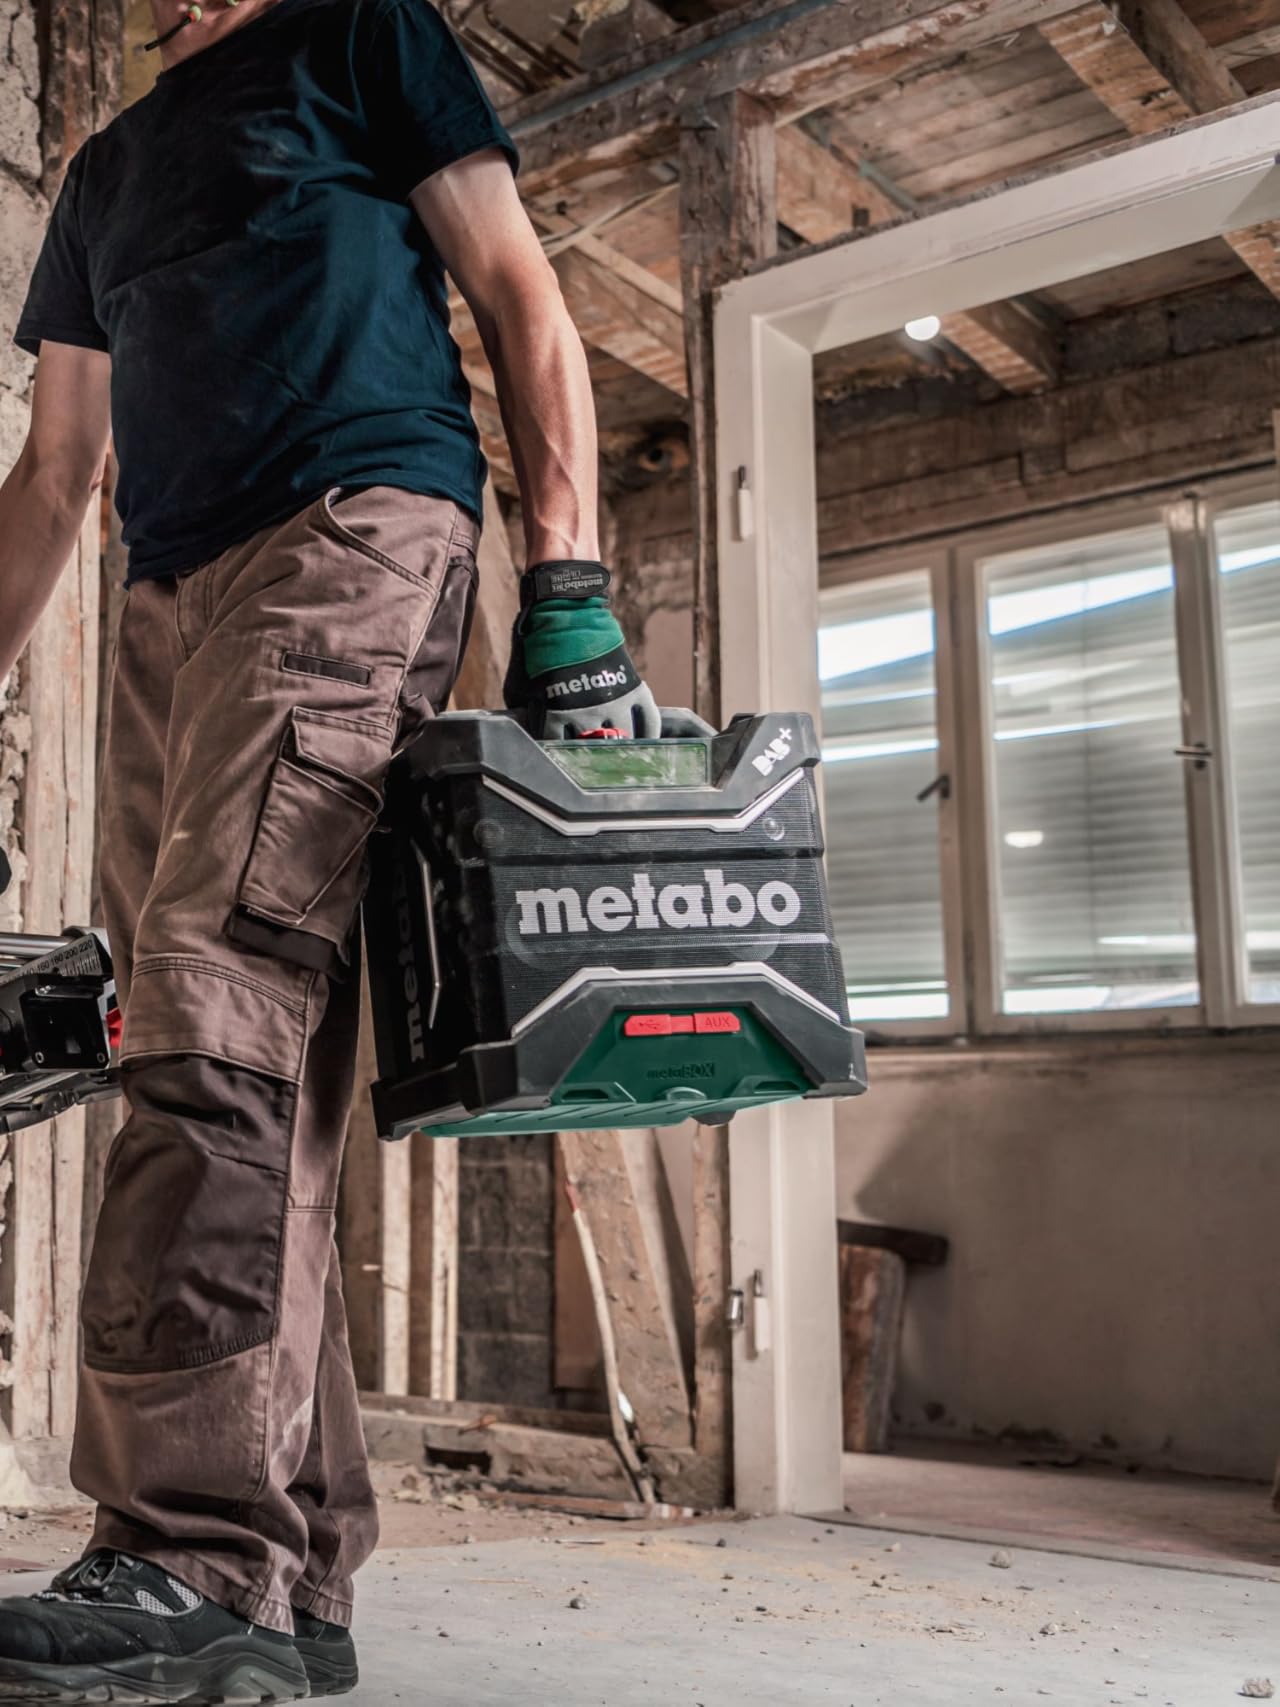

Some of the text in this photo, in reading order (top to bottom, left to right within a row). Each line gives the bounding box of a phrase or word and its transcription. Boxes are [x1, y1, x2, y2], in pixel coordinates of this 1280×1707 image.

[545, 669, 628, 699] metabo
[751, 727, 793, 777] DAB+
[515, 868, 801, 935] metabo
[65, 946, 77, 960] 200
[79, 939, 93, 953] 220
[705, 1016, 731, 1028] AUX
